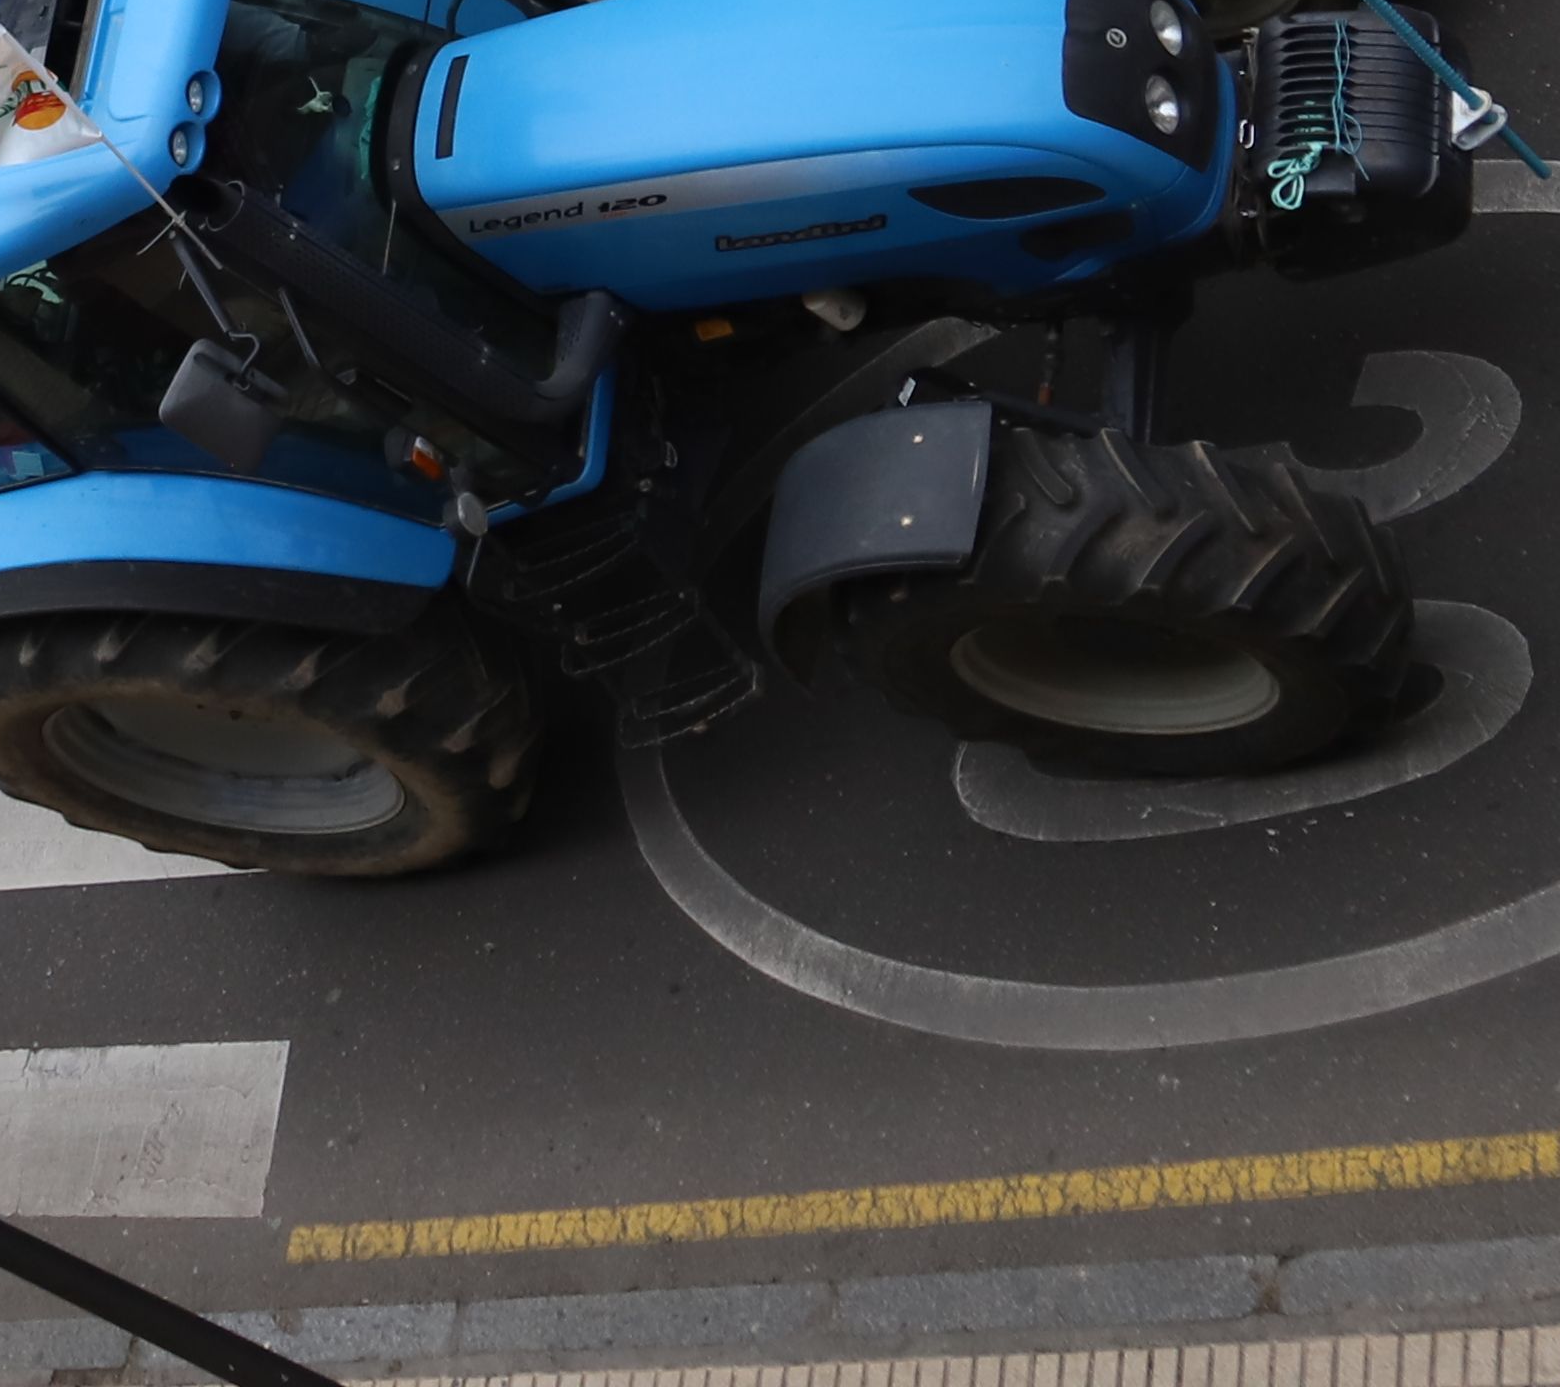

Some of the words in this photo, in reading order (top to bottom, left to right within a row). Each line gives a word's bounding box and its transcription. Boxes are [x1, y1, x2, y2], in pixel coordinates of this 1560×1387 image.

[469, 201, 585, 235] Legend
[597, 193, 668, 214] 120
[715, 213, 888, 252] landini
